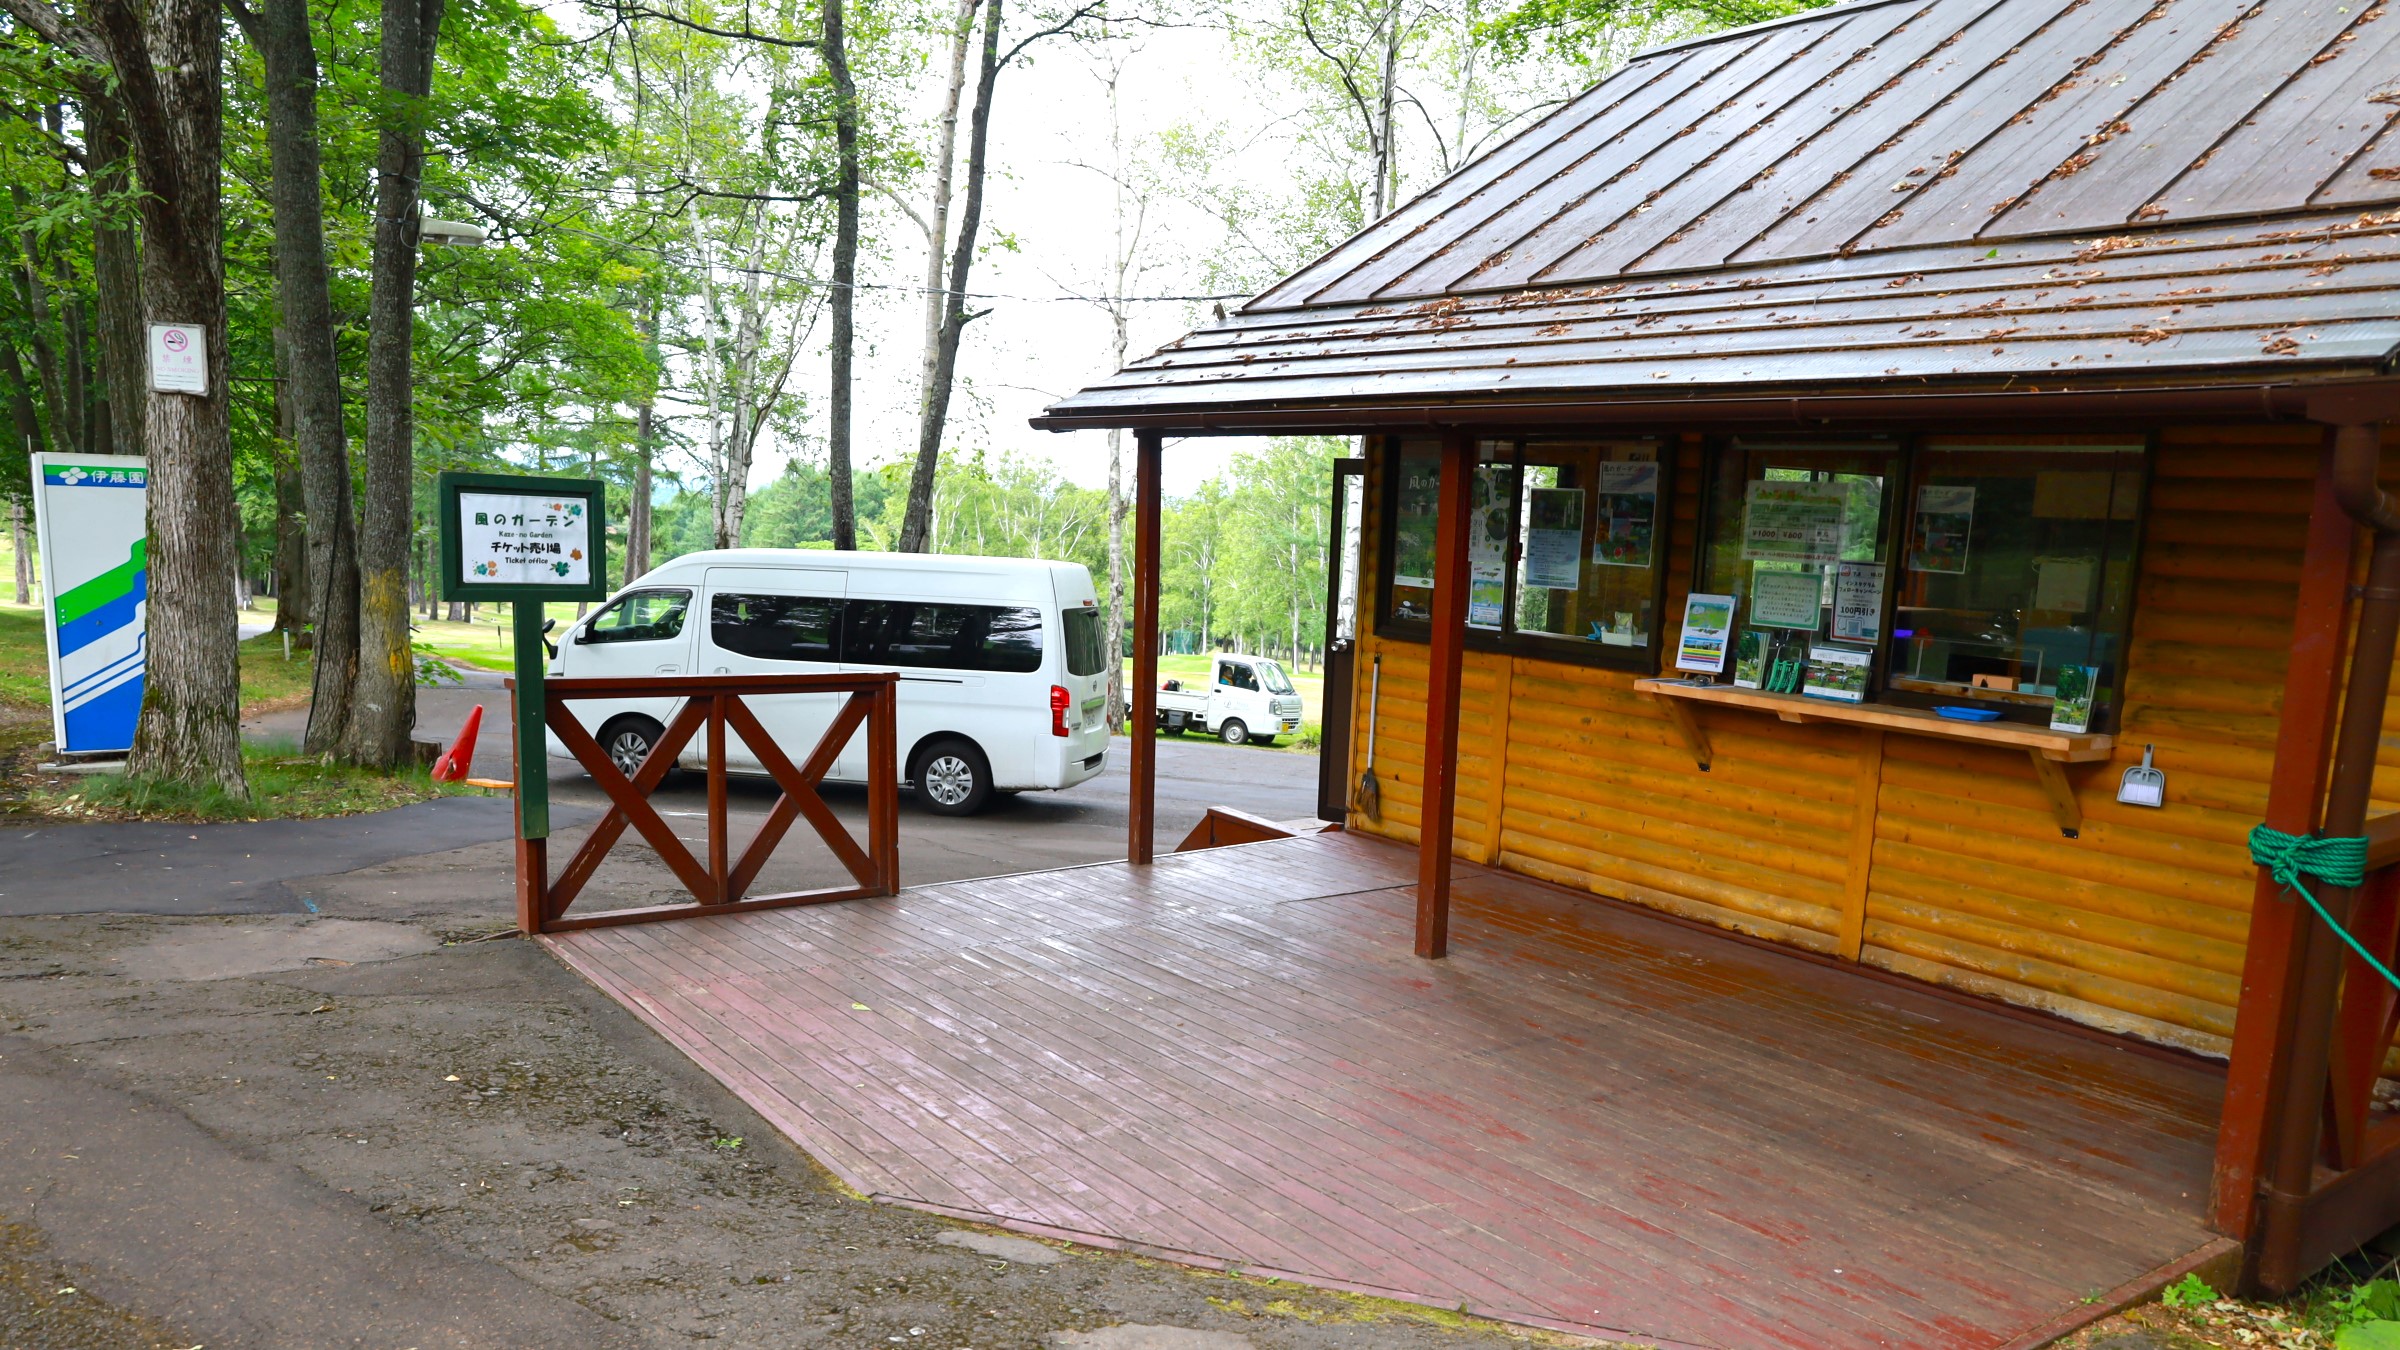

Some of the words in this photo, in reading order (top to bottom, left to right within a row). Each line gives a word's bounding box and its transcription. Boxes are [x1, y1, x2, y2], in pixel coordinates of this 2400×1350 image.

[91, 470, 144, 484] 伊藤園
[475, 512, 574, 527] 風のガーデン
[491, 541, 561, 554] チケット売り場
[1840, 606, 1876, 617] 100円引き
